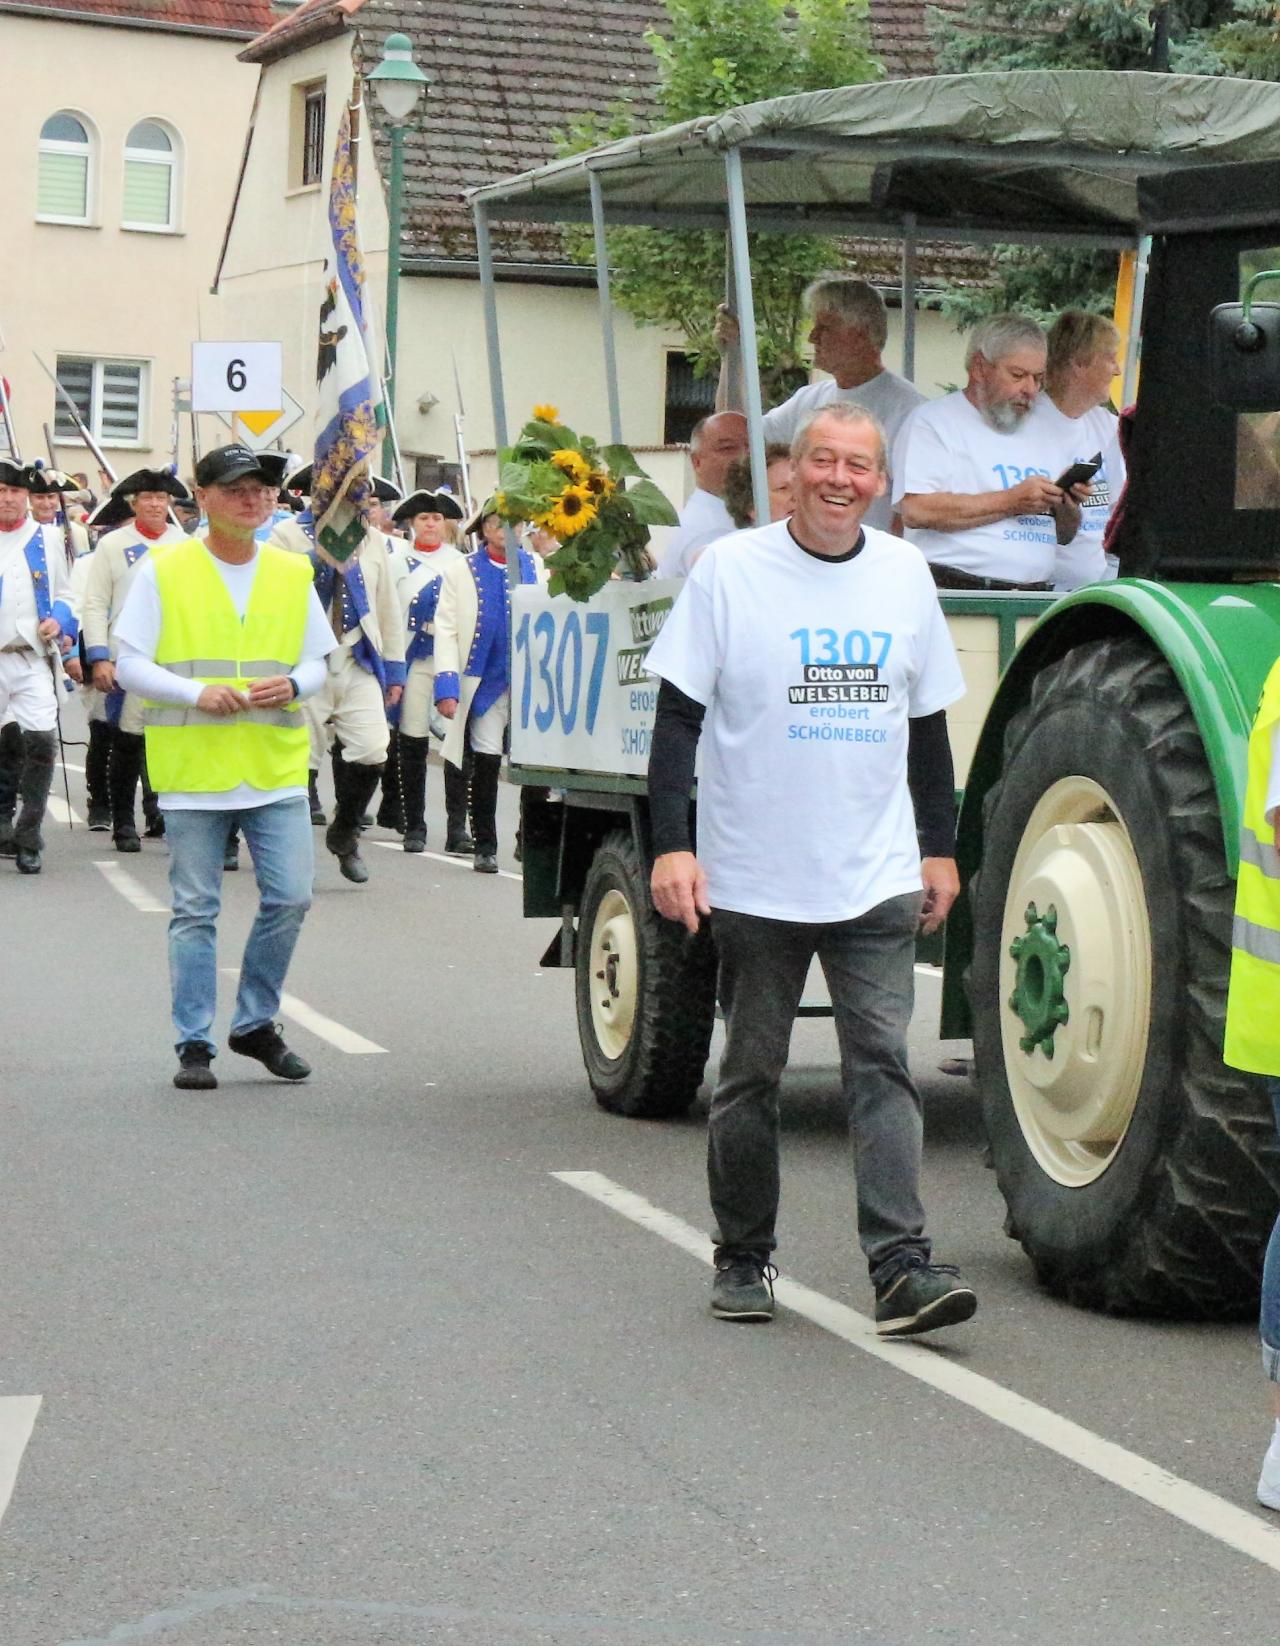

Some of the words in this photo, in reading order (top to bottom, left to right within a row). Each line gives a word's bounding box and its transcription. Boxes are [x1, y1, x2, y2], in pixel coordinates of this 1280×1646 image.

[227, 359, 247, 392] 6
[789, 627, 893, 669] 1307
[515, 610, 610, 736] 1307
[807, 666, 843, 681] Otto
[847, 667, 875, 681] von
[789, 686, 888, 703] WELSLEBEN
[809, 703, 871, 721] erobert
[788, 722, 887, 743] SCHÖNEBECK
